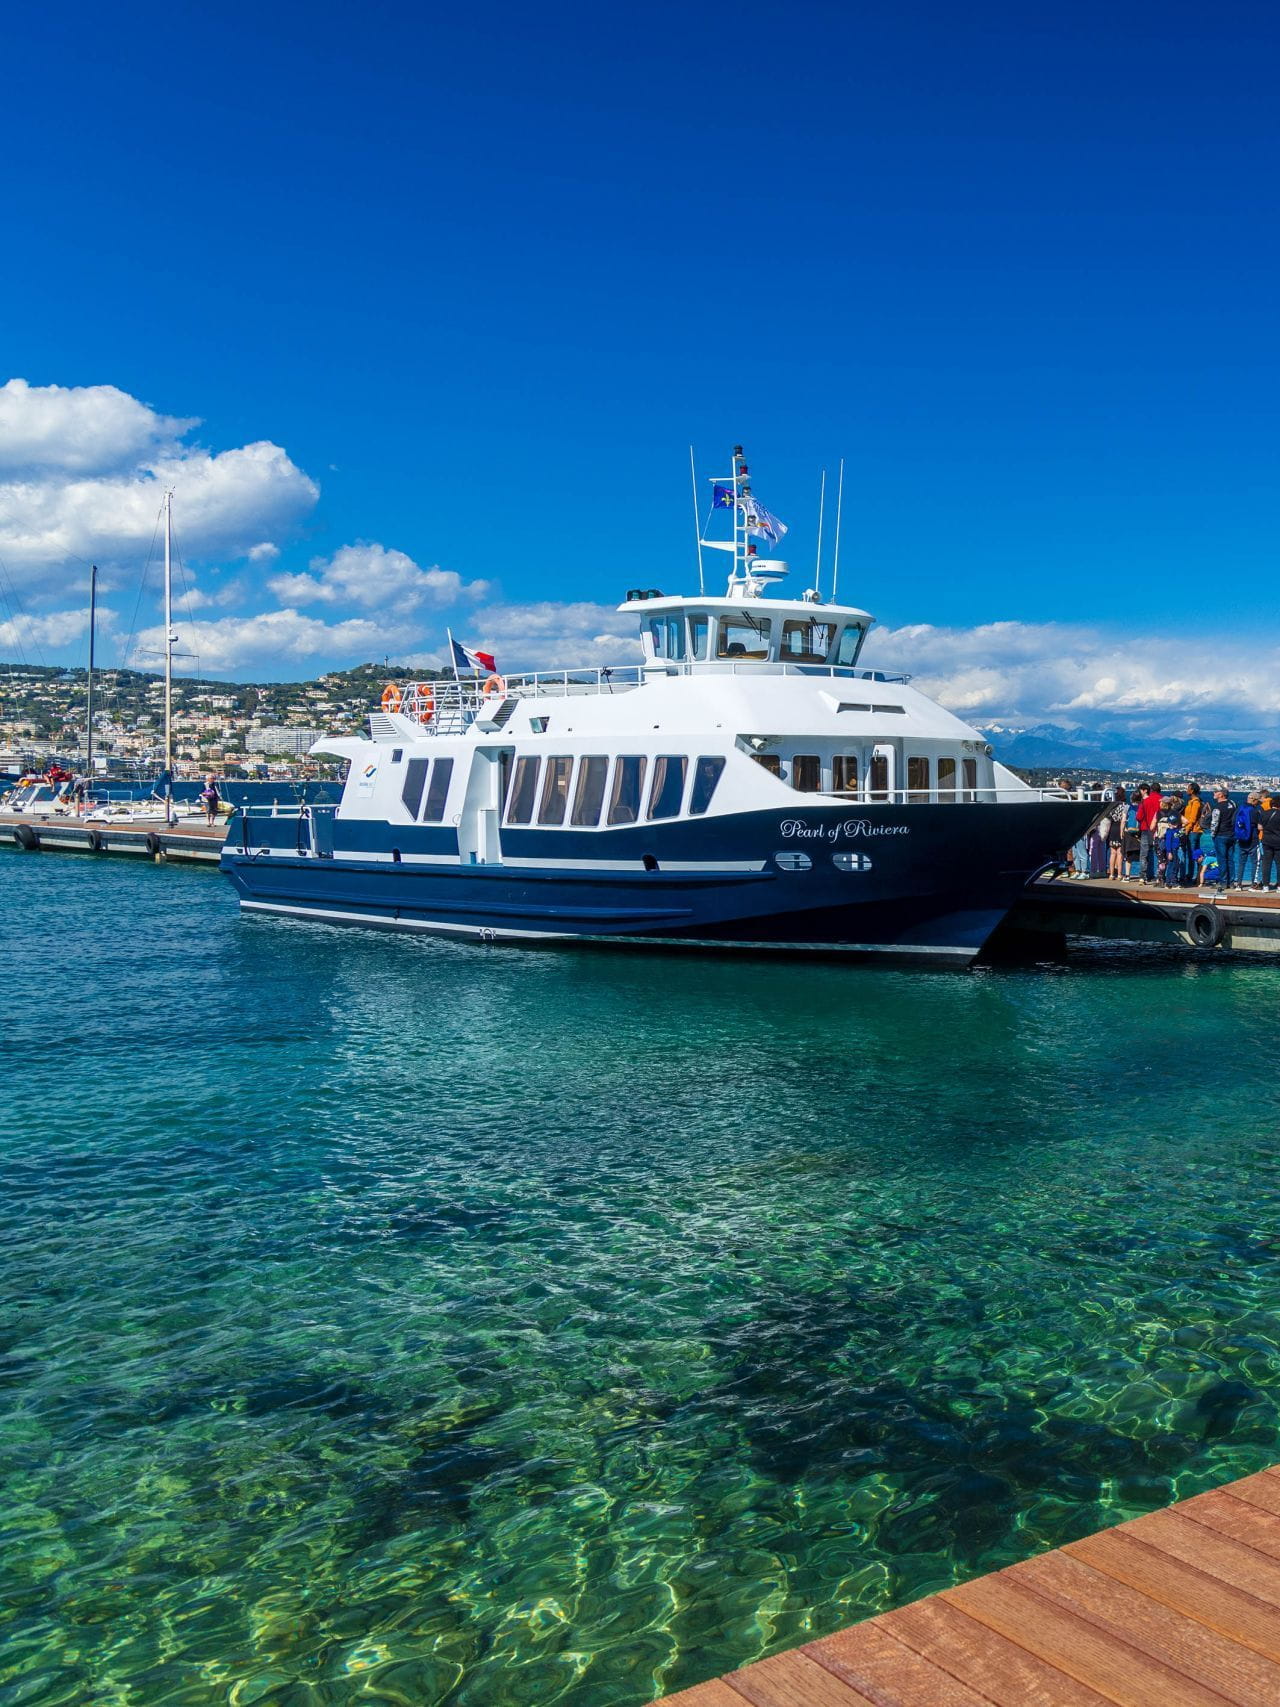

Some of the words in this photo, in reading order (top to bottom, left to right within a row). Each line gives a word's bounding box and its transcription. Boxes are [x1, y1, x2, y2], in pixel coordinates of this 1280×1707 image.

[780, 819, 825, 838] Pearl
[828, 822, 843, 844] of
[843, 819, 911, 838] Riviera
